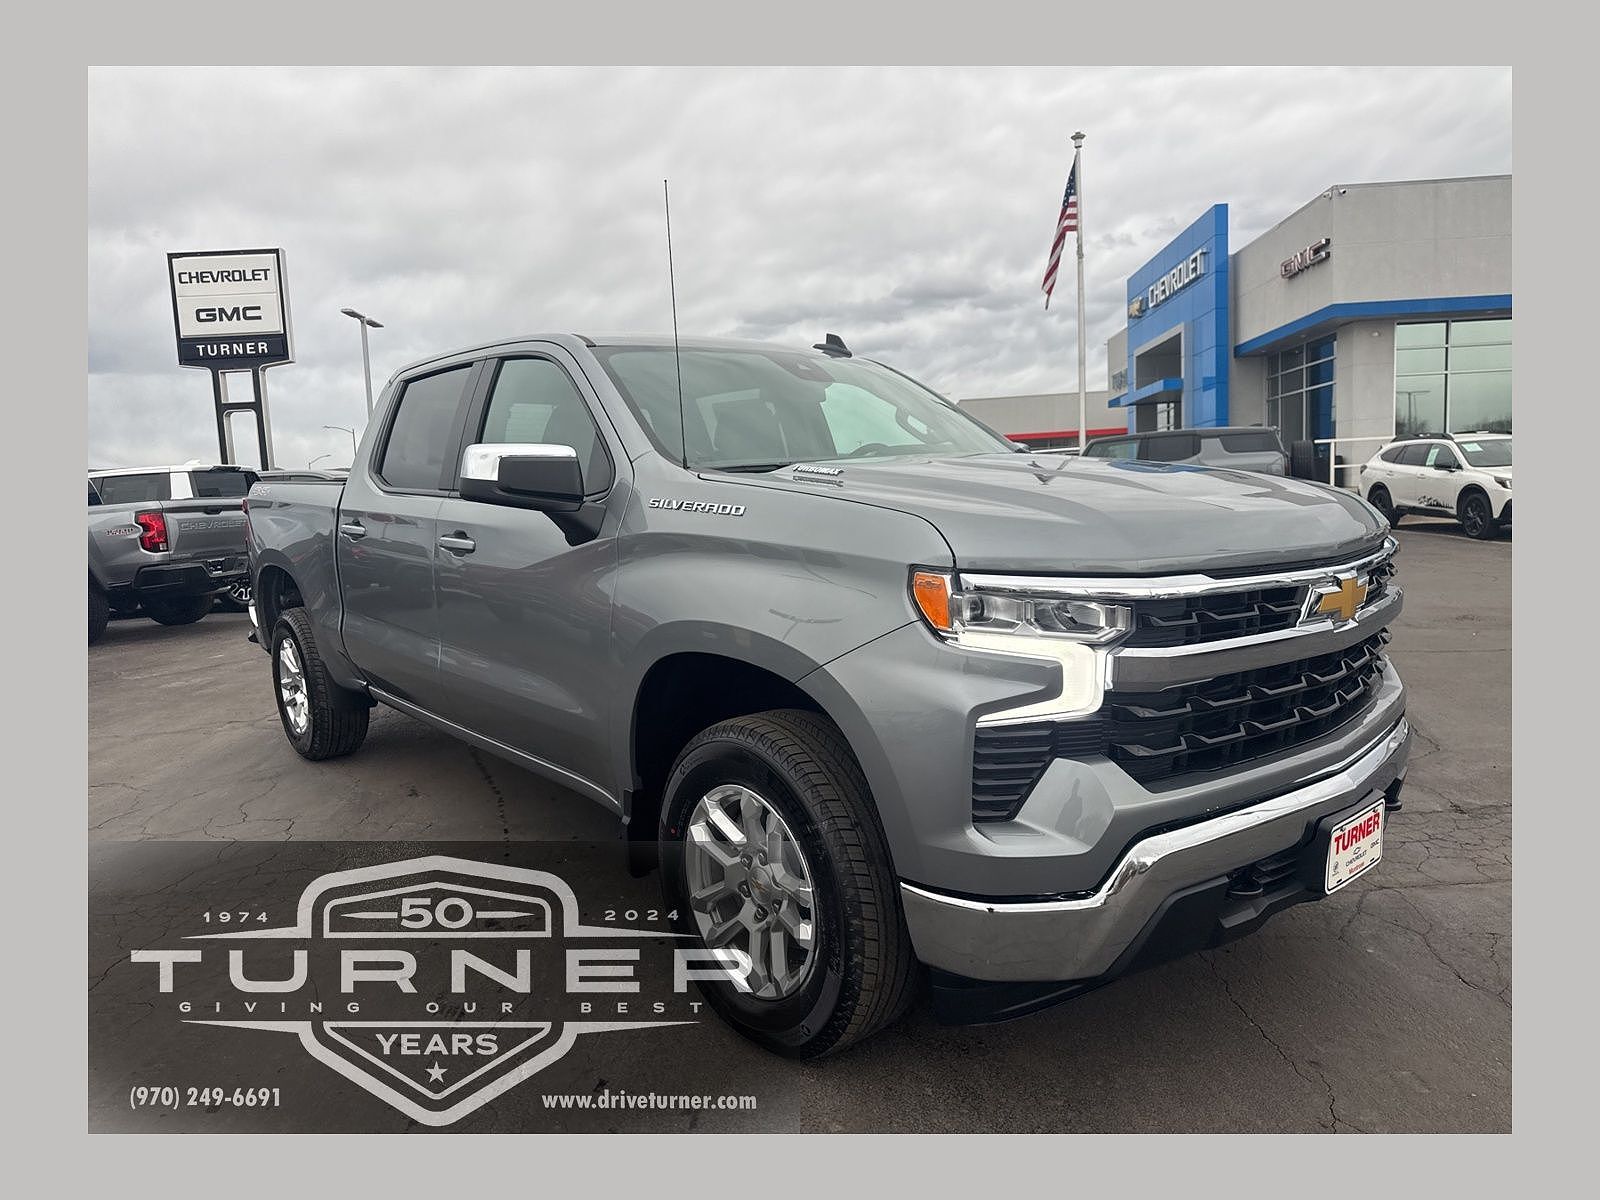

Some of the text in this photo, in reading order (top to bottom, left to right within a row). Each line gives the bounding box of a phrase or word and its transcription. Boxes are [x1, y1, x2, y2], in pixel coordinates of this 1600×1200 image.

[1281, 238, 1330, 279] GMC
[178, 268, 270, 284] CHEVROLET
[1148, 247, 1207, 309] CHEVROLET
[195, 306, 262, 323] GMC
[196, 342, 268, 357] TURNER
[649, 498, 746, 517] SILVERADO
[1334, 813, 1380, 855] TURNER
